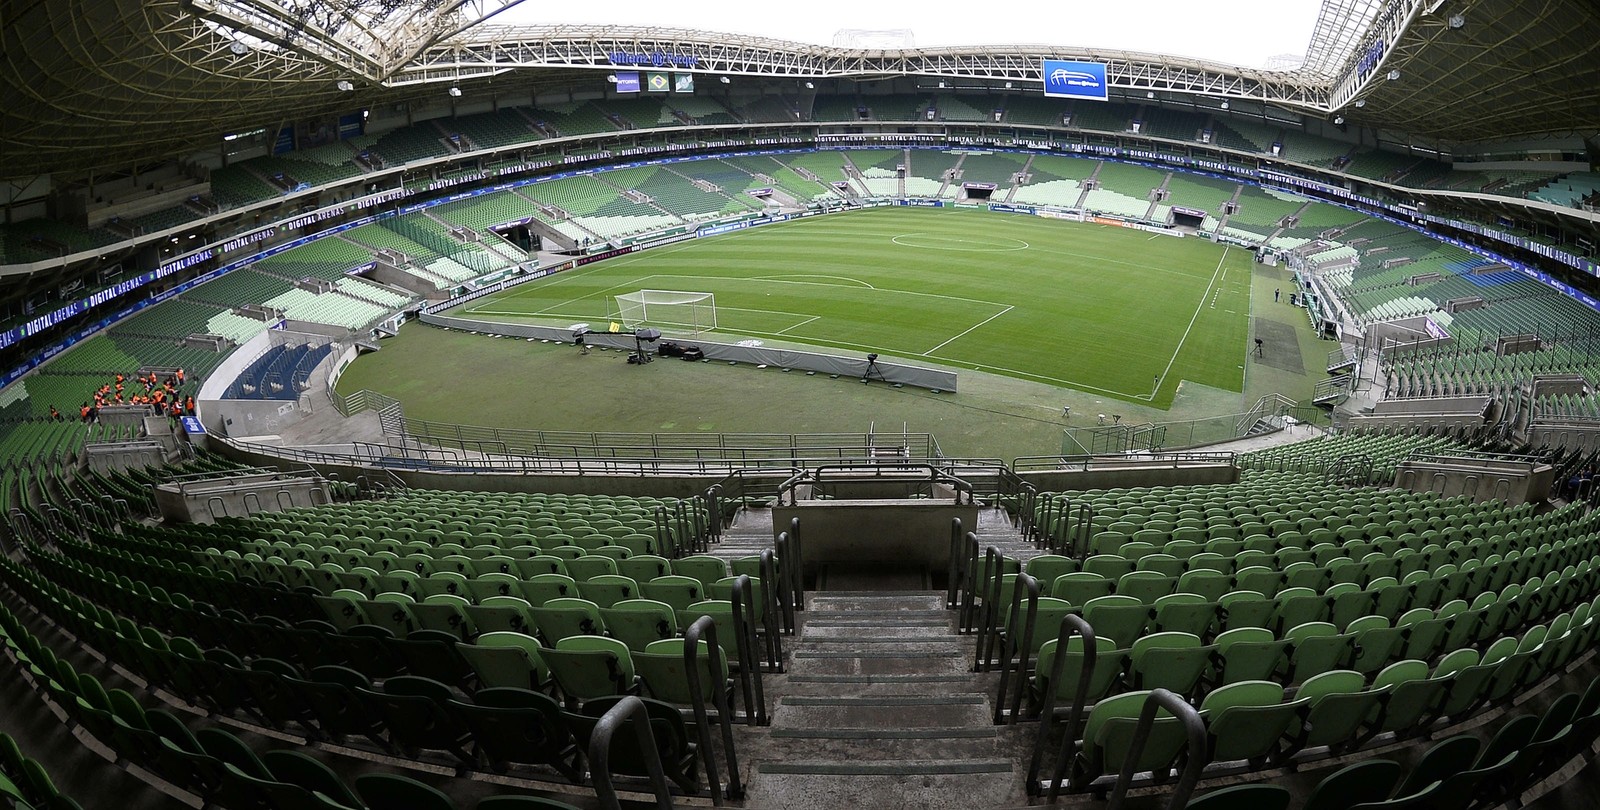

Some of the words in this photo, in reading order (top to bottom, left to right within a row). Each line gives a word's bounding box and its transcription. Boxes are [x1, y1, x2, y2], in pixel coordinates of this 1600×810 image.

[609, 52, 649, 64] Allianz
[666, 53, 698, 67] Parque
[621, 147, 643, 156] DIGITAL
[644, 146, 663, 154] ARENAS
[666, 144, 685, 152] DIGITAL
[1012, 138, 1036, 146] DIGITAL
[1038, 140, 1060, 148] ARENAS
[1071, 143, 1094, 151] DIGITAL
[1095, 146, 1117, 154] ARENAS
[564, 153, 588, 165] DIGITAL
[589, 151, 611, 161] ARENAS
[1130, 149, 1157, 159] DIGITAL
[1158, 154, 1185, 163] ARENAS
[500, 162, 526, 176] DIGITAL
[528, 160, 552, 170] ARENAS
[1198, 160, 1226, 170] DIGITAL
[1227, 165, 1254, 176] ARENAS
[429, 176, 458, 191] DIGITAL
[460, 172, 486, 184] ARENAS
[1267, 173, 1294, 184] DIGITAL
[1295, 180, 1320, 191] ARENAS
[357, 195, 386, 210] DIGITAL
[387, 188, 415, 201] ARENAS
[1332, 189, 1358, 201] DIGITAL
[1359, 195, 1380, 207] ARENAS
[288, 214, 316, 230] DIGITAL
[317, 207, 345, 221] ARENAS
[1389, 204, 1408, 216] DIGITAL
[223, 236, 249, 253] DIGITAL
[250, 228, 275, 243] ARENAS
[1483, 227, 1501, 240] DIGITAL
[1501, 233, 1520, 247] ARENAS
[1530, 241, 1554, 259] DIGITAL
[1554, 248, 1580, 269] ARENAS
[156, 260, 186, 279] DIGITAL
[187, 250, 213, 267] ARENAS
[90, 287, 117, 307] DIGITAL
[118, 276, 143, 295] ARENAS
[26, 314, 53, 336] DIGITAL
[53, 302, 78, 324] ARENAS
